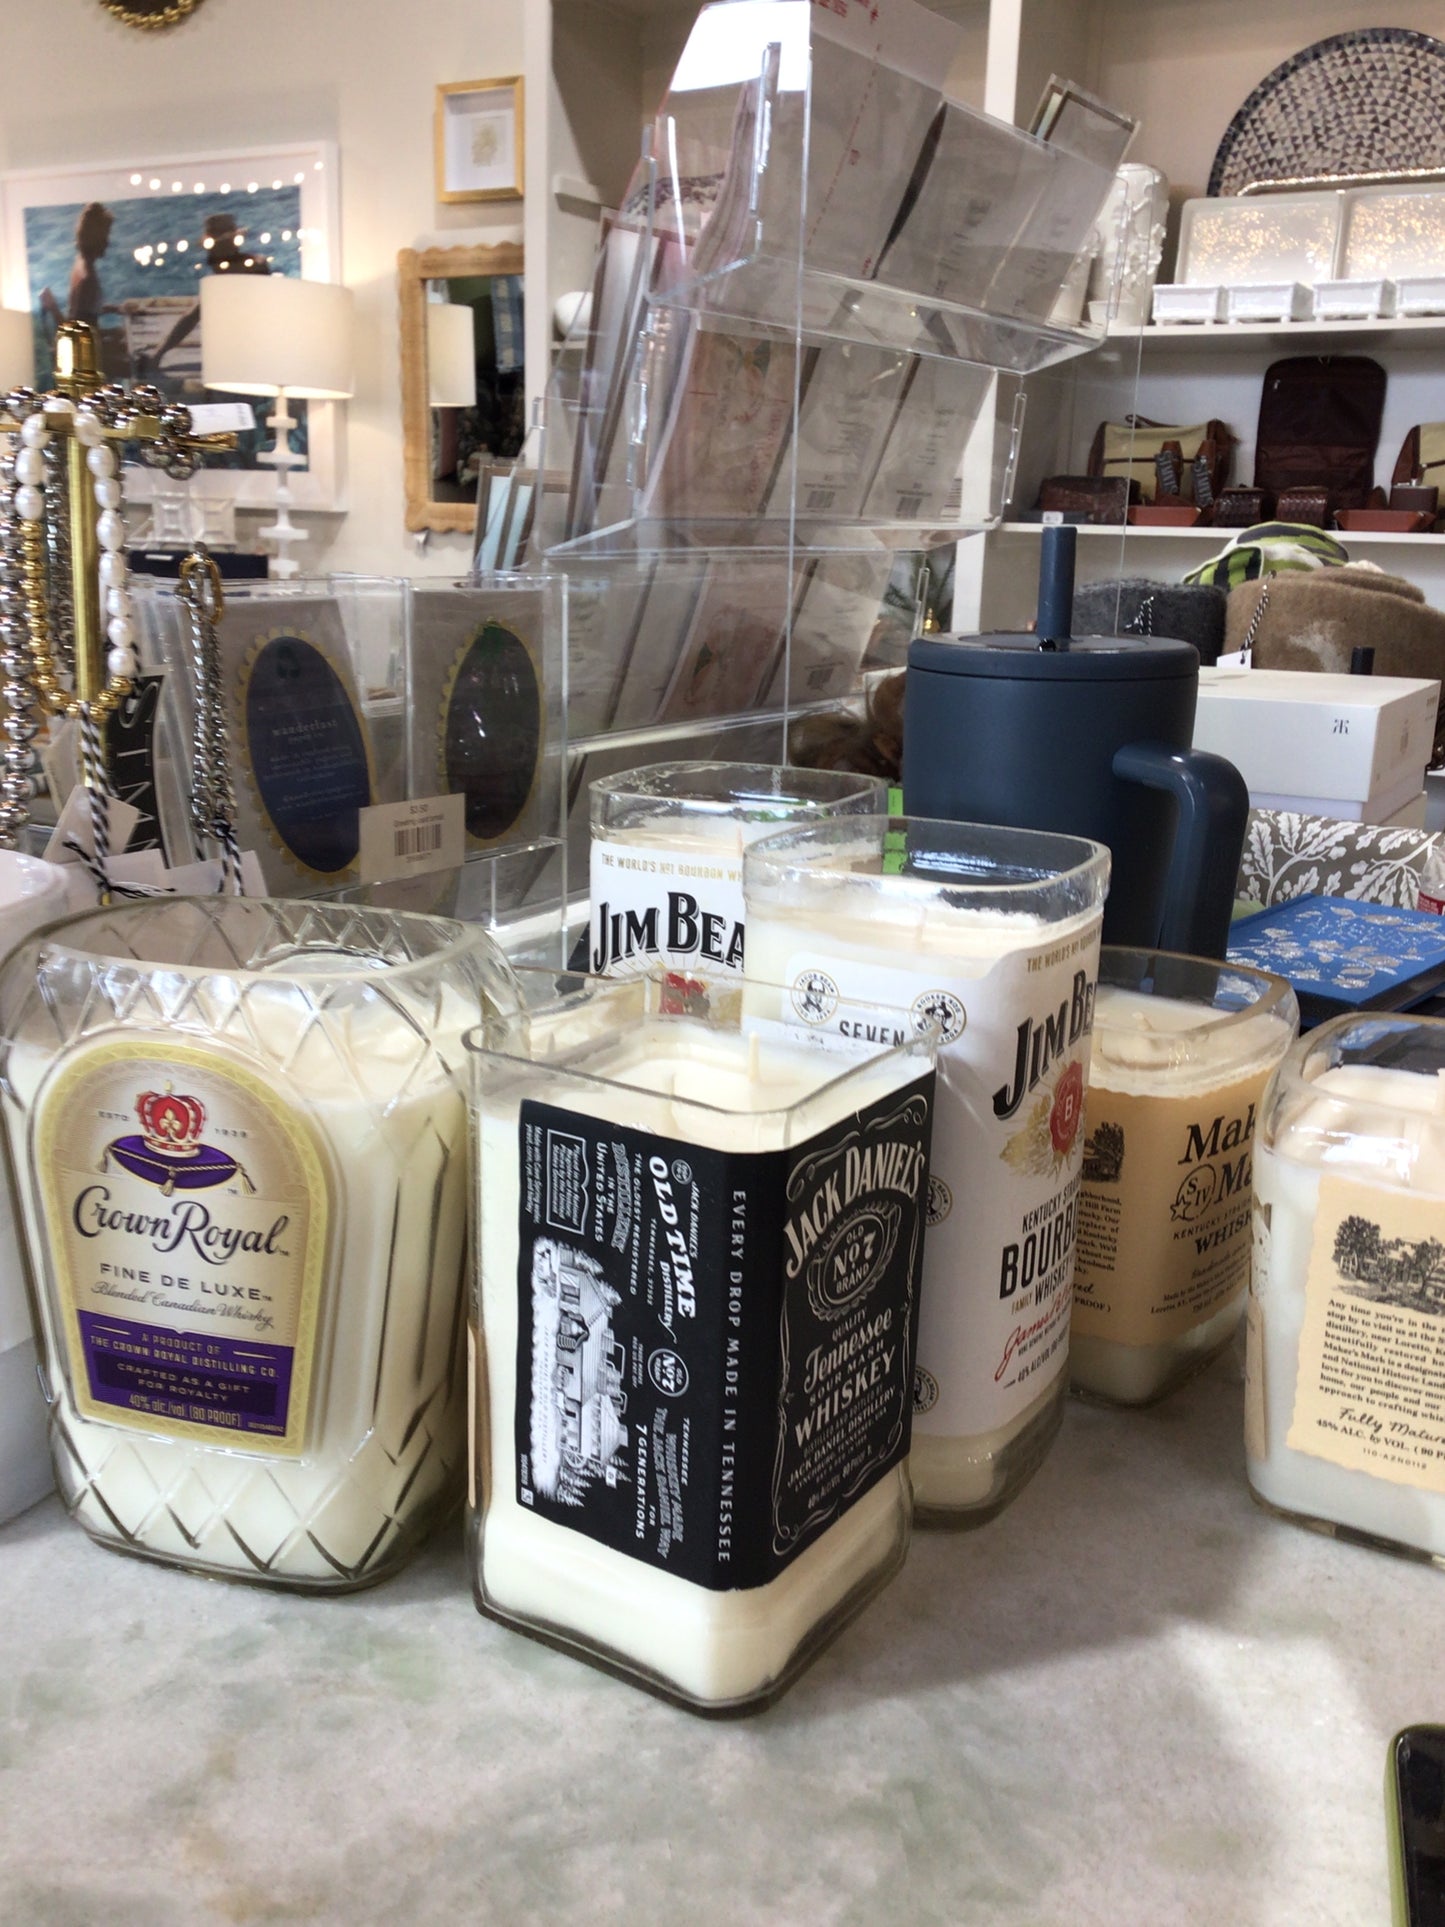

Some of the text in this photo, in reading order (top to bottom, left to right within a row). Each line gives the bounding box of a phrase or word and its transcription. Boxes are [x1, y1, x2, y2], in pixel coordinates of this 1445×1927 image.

[602, 853, 614, 867] THE
[617, 857, 656, 873] WORLD'S
[678, 864, 723, 880] BOURBON
[593, 901, 660, 975] JIM
[1027, 944, 1070, 973] THE WORLD'S
[839, 1019, 905, 1048] SEVEN
[992, 999, 1068, 1120] JIM
[533, 1125, 543, 1147] Made
[533, 1146, 542, 1162] with
[525, 1178, 534, 1214] and barley
[533, 1180, 543, 1204] Spring
[551, 1143, 560, 1215] States Government
[558, 1180, 566, 1193] the
[565, 1146, 574, 1219] Register Historic
[571, 1143, 581, 1226] Placed the National
[594, 1141, 608, 1243] UNITED STATES
[606, 1176, 616, 1214] IN THE
[611, 1141, 632, 1254] DISTILLERY
[558, 1193, 567, 1220] United
[630, 1152, 642, 1296] THE OLDEST REGISTERED
[688, 1181, 700, 1260] JACK DANIEL'S
[783, 1140, 926, 1279] JACK DANIEL'S
[1022, 1191, 1062, 1234] KENTUCKY
[72, 1185, 289, 1266] Crown Royal
[649, 1155, 697, 1319] OLD TIME
[846, 1224, 865, 1245] OLD
[1173, 1216, 1221, 1240] KENTUCKY
[100, 1263, 151, 1284] FINE
[160, 1274, 190, 1290] DE
[836, 1263, 870, 1294] BRAND
[1035, 1261, 1069, 1307] WHISKEY
[91, 1280, 274, 1332] Blended Canadian Whisky
[658, 1260, 676, 1337] DISTILLERY
[1328, 1299, 1437, 1332] Any time you're in the
[832, 1305, 868, 1342] QUALITY
[1326, 1320, 1432, 1355] distillery, near Loretto,
[1327, 1310, 1346, 1322] stop
[1348, 1314, 1359, 1325] by
[1361, 1319, 1371, 1327] to
[1373, 1322, 1393, 1333] visit
[1408, 1330, 1418, 1338] at
[1420, 1332, 1436, 1343] the
[90, 1335, 279, 1379] THE CROWN ROYAL DISTILLING CO.
[141, 1333, 222, 1355] A PRODUCT OF
[803, 1307, 893, 1395] Tennessee
[1323, 1341, 1359, 1357] Maker's
[1360, 1351, 1385, 1364] Mark
[1388, 1358, 1395, 1366] is
[1325, 1330, 1378, 1351] beautifully
[1384, 1347, 1427, 1363] restored
[116, 1362, 252, 1394] CRAFTED AS A GIFT
[717, 1189, 747, 1562] EVERY DROP MADE IN TENNESSEE
[809, 1370, 842, 1407] SOUR
[847, 1339, 885, 1374] MASH
[1321, 1362, 1423, 1395] love for you to discover
[1322, 1352, 1419, 1384] and National Historic
[129, 1393, 150, 1411] 40%
[189, 1405, 206, 1421] (80
[138, 1378, 229, 1401] FOR ROYALTY
[795, 1343, 896, 1447] WHISKEY
[1319, 1384, 1418, 1418] approach to crafting
[1320, 1372, 1440, 1411] home, our people and our
[814, 1428, 845, 1462] DANIEL
[848, 1385, 895, 1433] DISTILLERY
[1316, 1418, 1410, 1451] 45% ALC. by VOL.
[1339, 1406, 1383, 1434] Fully
[680, 1417, 690, 1487] TENNESSEE
[635, 1423, 648, 1540] 7 GENERATIONS
[652, 1406, 672, 1560] THE JACK DANIEL WAY
[665, 1433, 684, 1543] WHISKEY MADE
[648, 1503, 657, 1527] FOR
